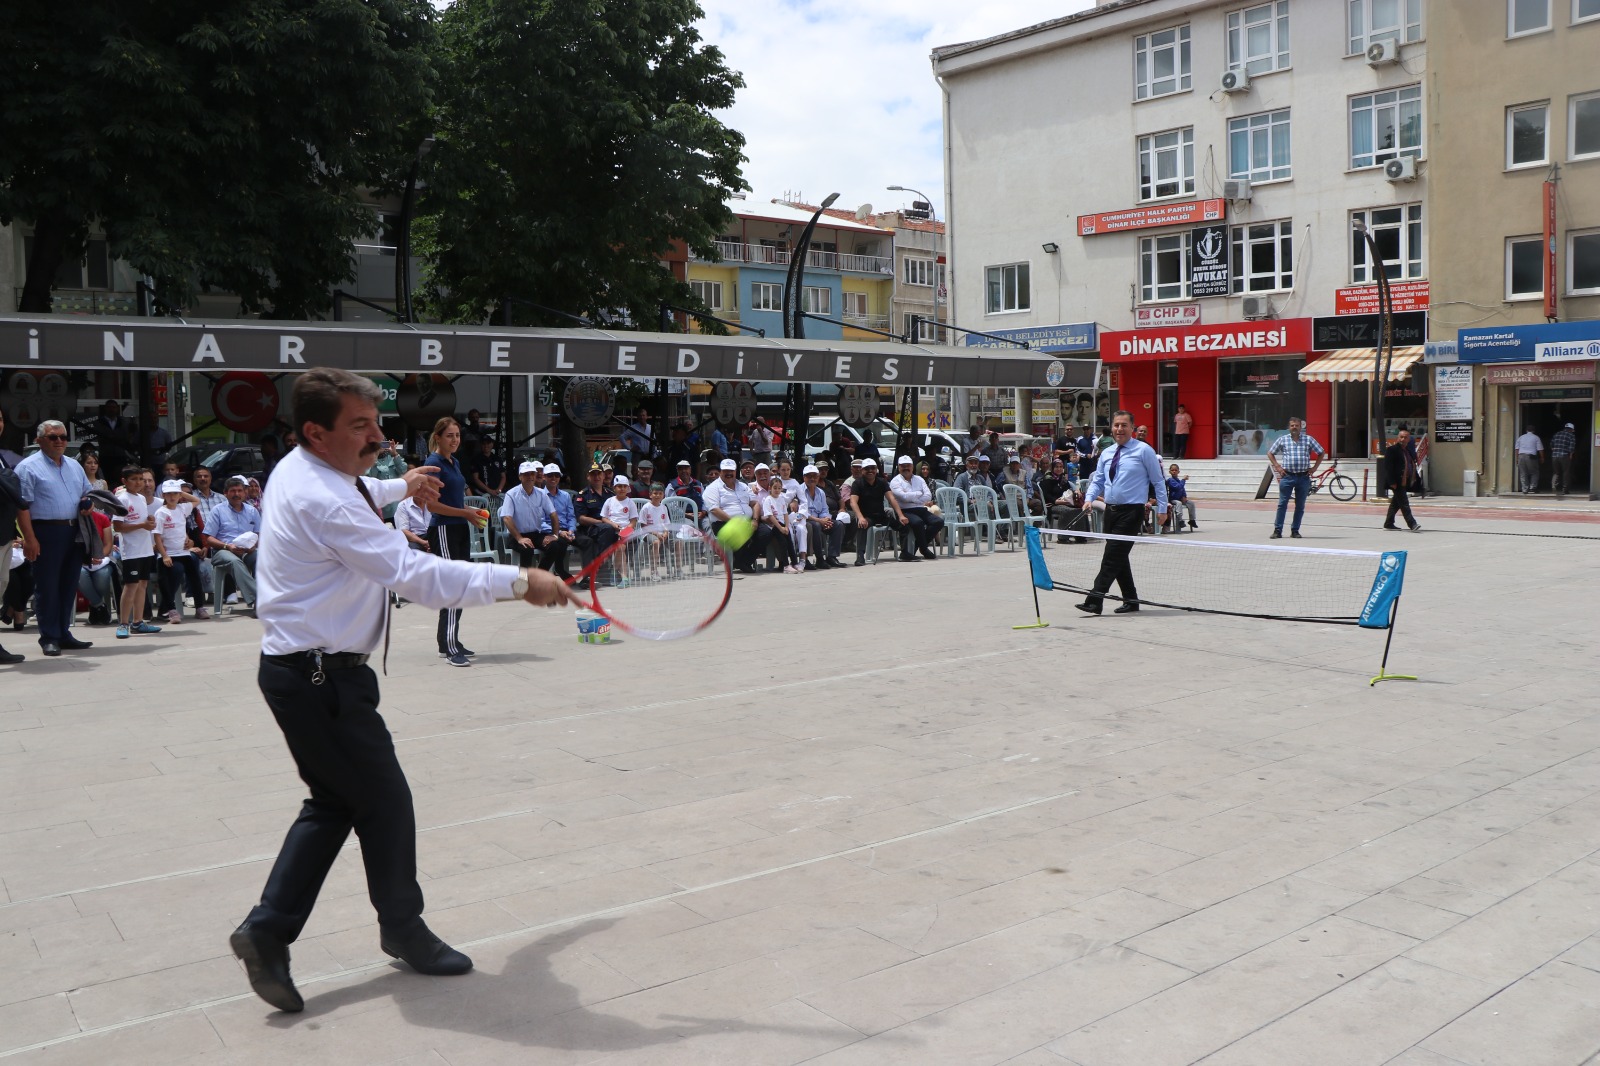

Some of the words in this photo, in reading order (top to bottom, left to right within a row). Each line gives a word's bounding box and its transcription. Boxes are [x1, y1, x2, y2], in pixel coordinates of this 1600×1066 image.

[1102, 211, 1145, 222] CUMHURİYET
[1148, 208, 1165, 216] HALK
[1168, 204, 1196, 214] PARTİSİ
[1108, 220, 1128, 229] DİNAR
[1130, 218, 1145, 228] İLÇE
[1193, 270, 1227, 282] AVUKAT
[1154, 308, 1179, 318] CHP
[1016, 328, 1070, 339] BELEDİYESİ
[1028, 334, 1087, 347] MERKEZİ
[1120, 336, 1178, 356] DİNAR
[1184, 326, 1286, 351] ECZANESİ
[1488, 339, 1521, 347] Acenteliği
[1543, 347, 1583, 357] Allianz
[1362, 575, 1388, 622] ARTENGO
